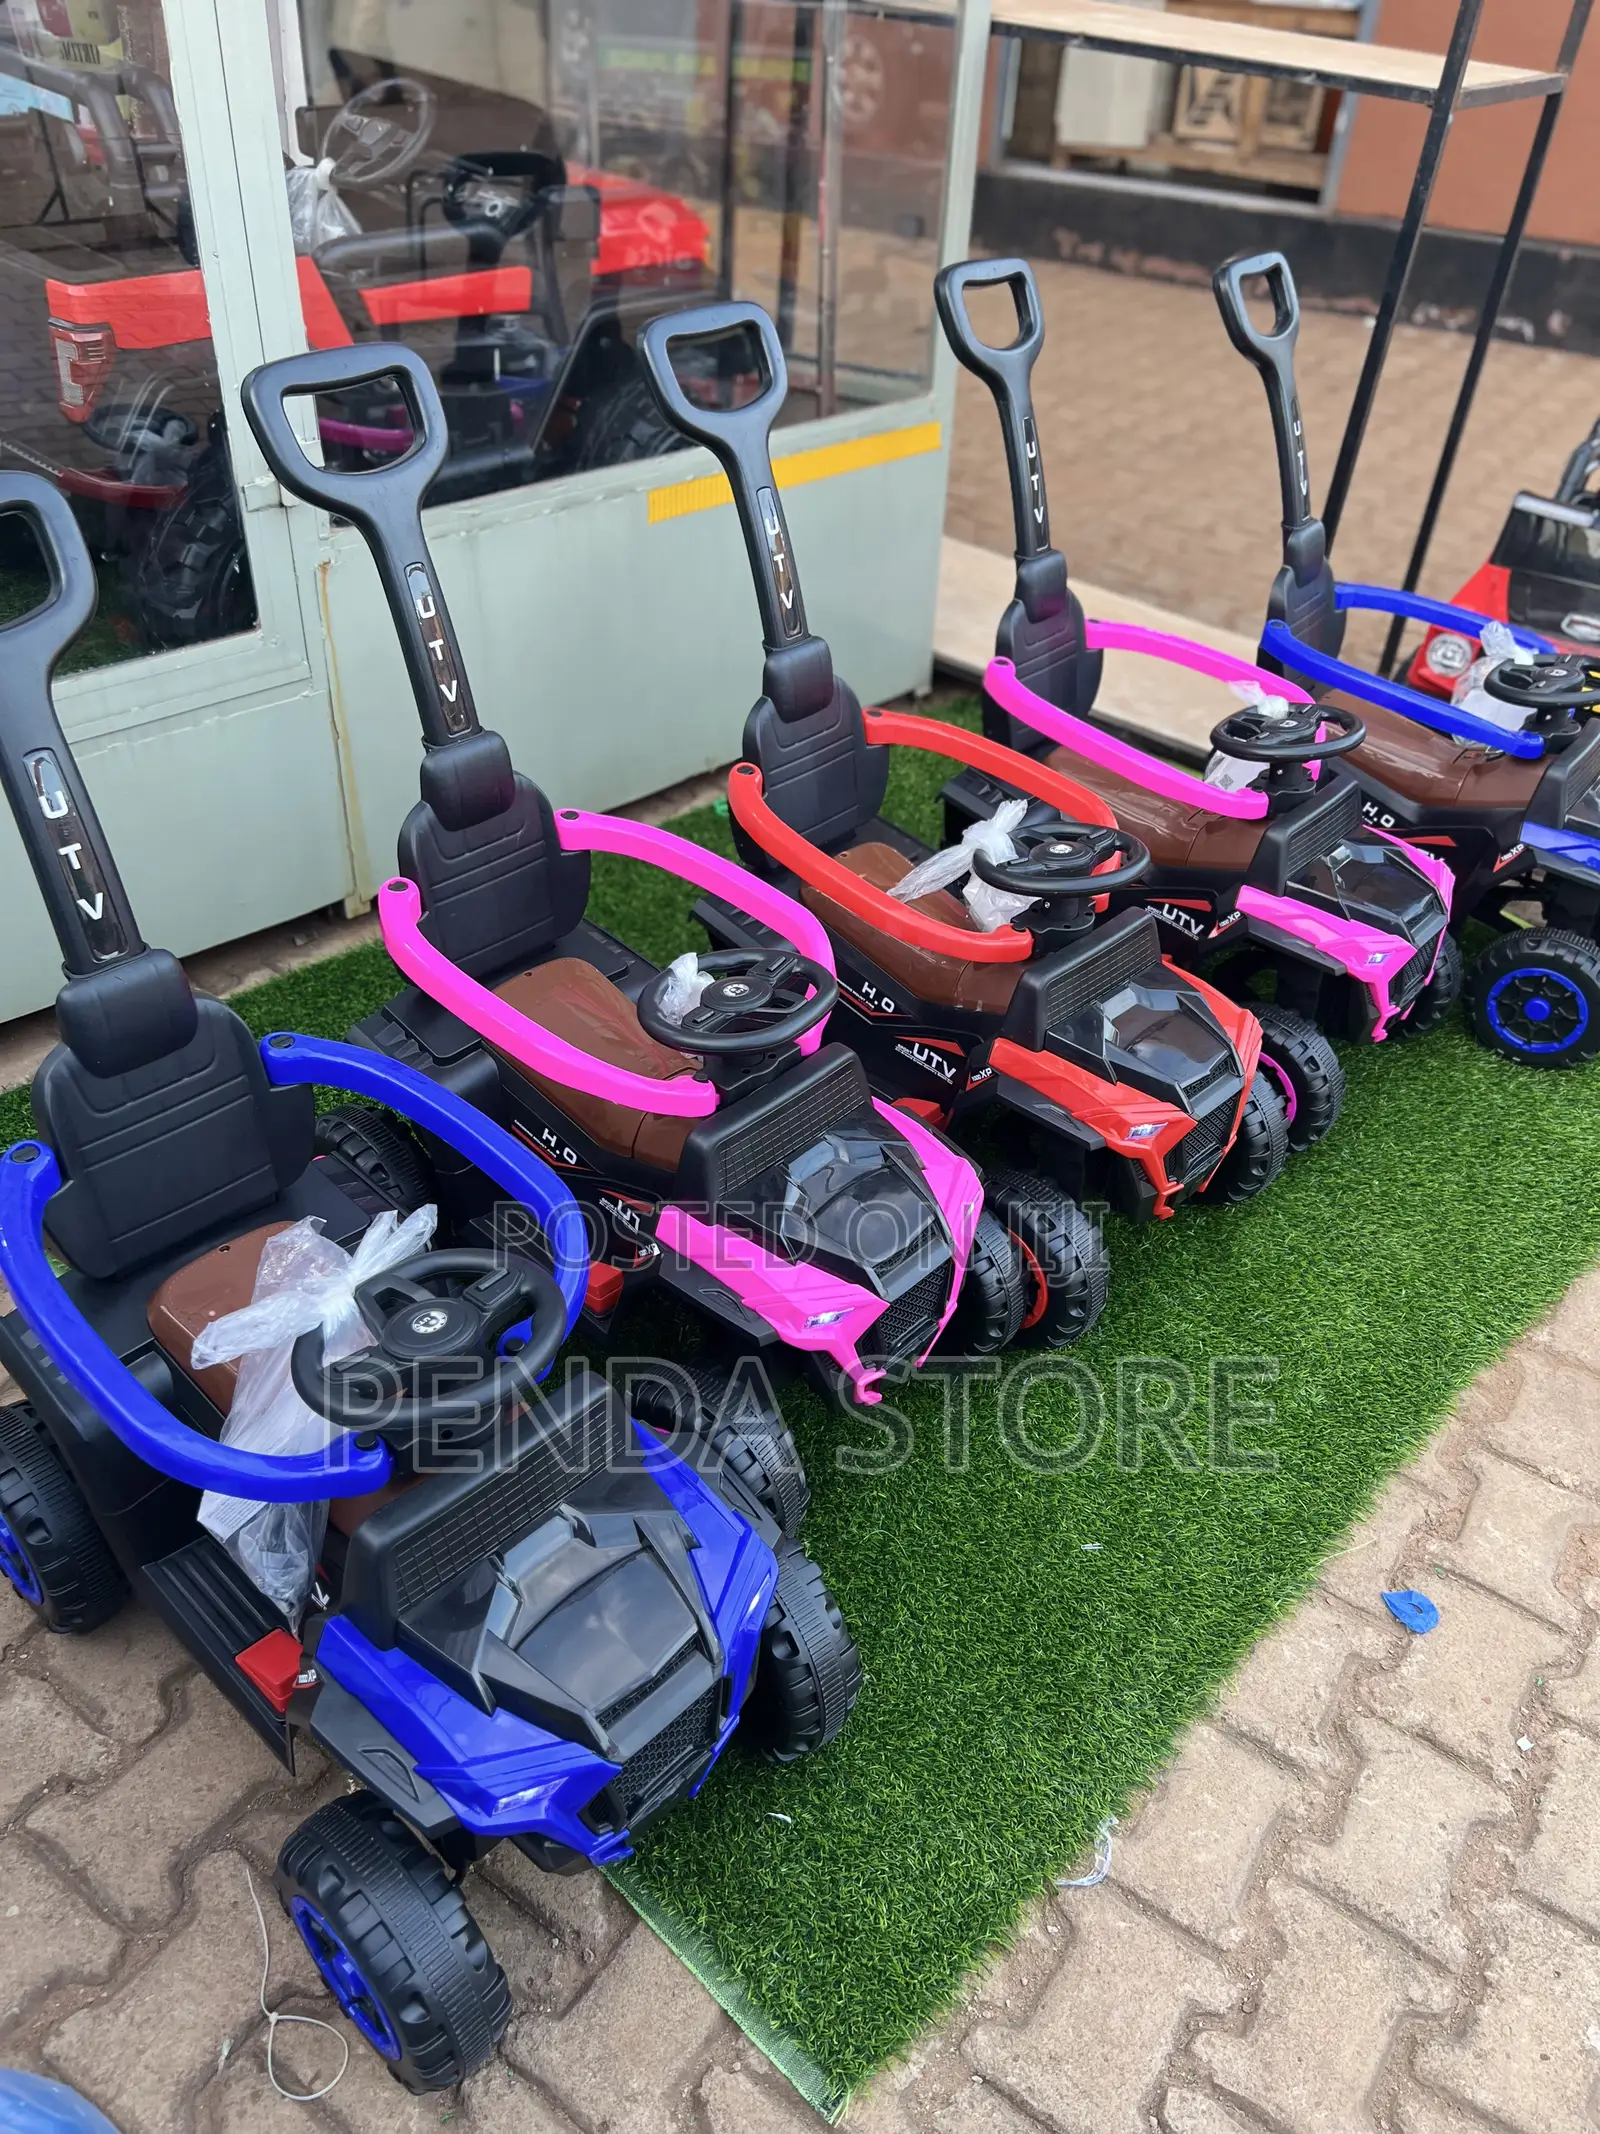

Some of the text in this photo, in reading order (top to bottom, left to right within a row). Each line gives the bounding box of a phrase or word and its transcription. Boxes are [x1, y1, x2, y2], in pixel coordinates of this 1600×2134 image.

[1026, 441, 1044, 524] UTV
[1293, 420, 1308, 496] UTV
[765, 515, 794, 610] UTV
[417, 595, 458, 702] UTV
[38, 790, 104, 921] UTV
[1162, 903, 1205, 935] UTV
[912, 1042, 957, 1079] UTV
